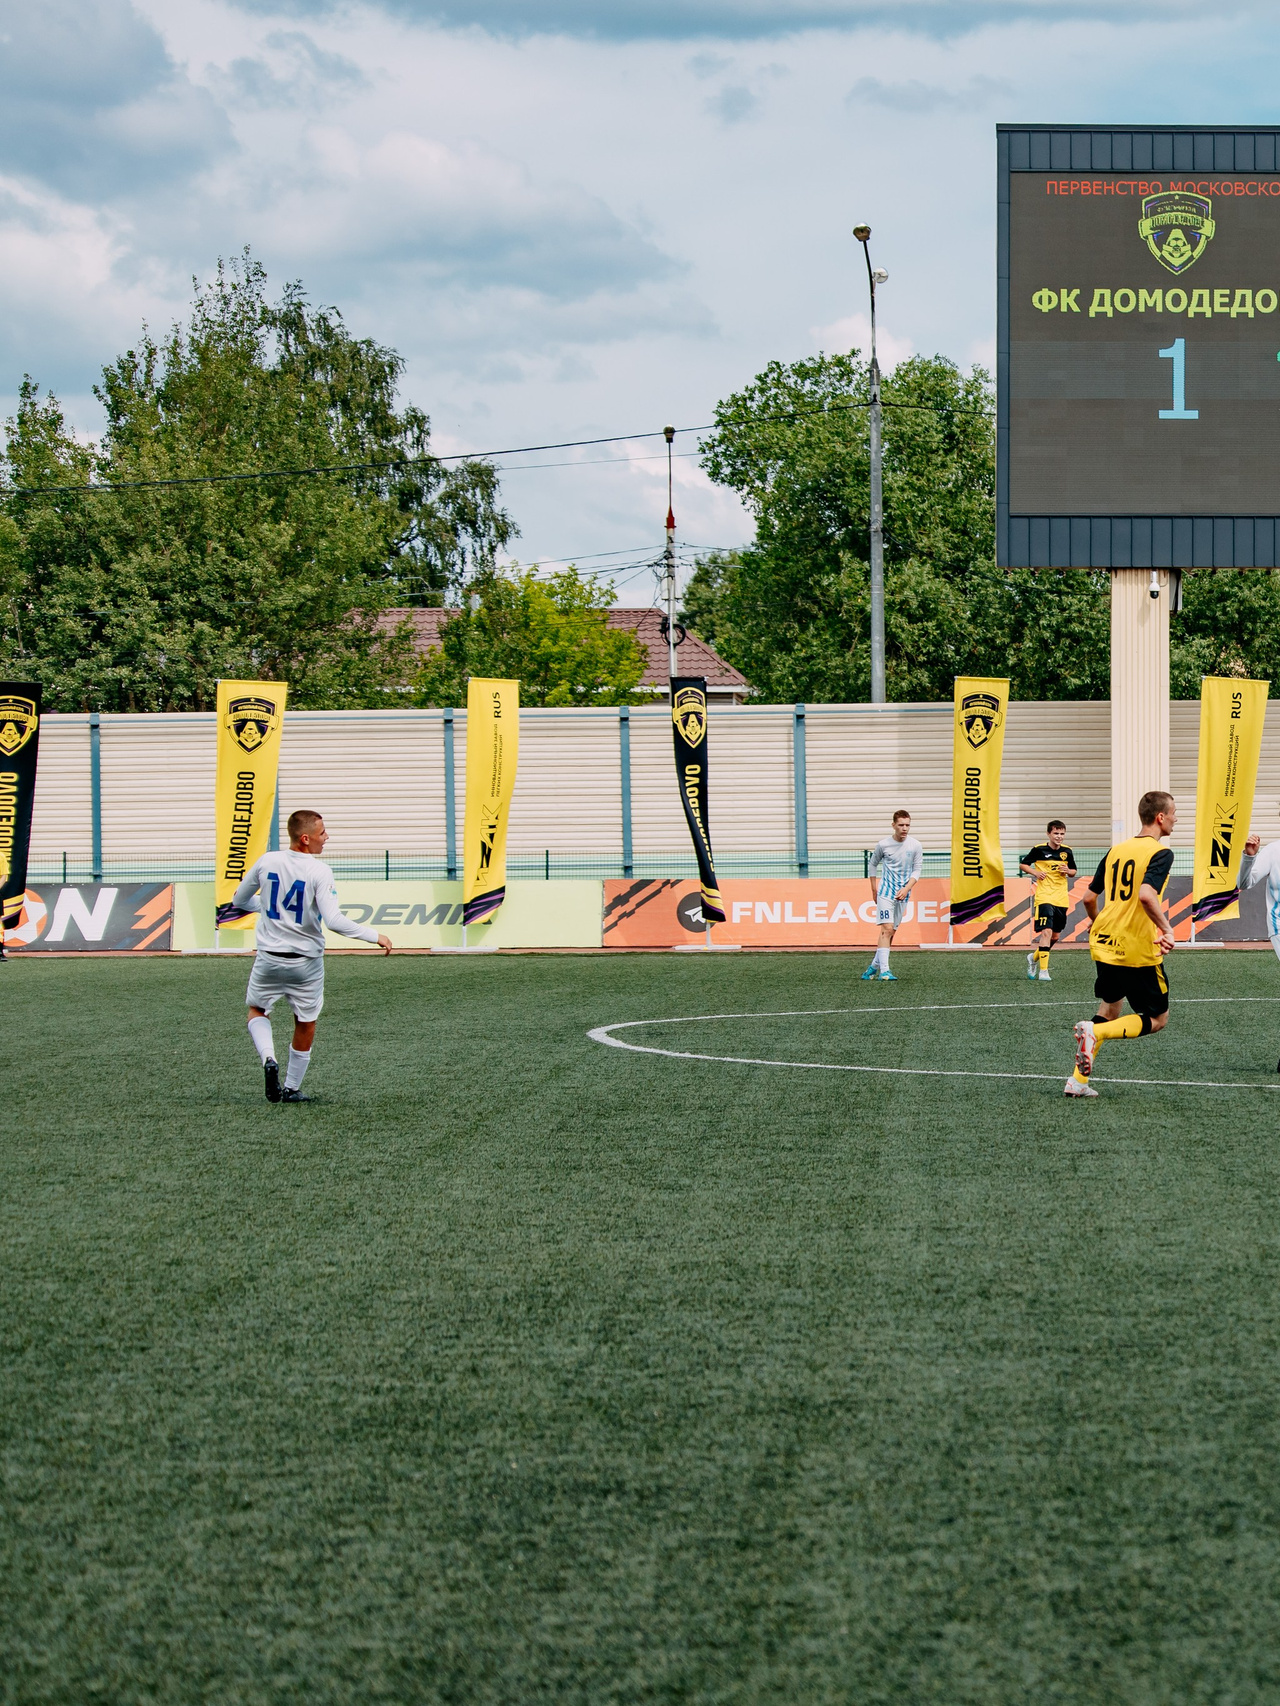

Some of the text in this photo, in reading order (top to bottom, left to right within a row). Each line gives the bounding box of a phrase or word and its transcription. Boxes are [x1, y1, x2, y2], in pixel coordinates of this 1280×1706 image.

[1046, 180, 1163, 196] ПЕРВЕНСТВО
[1031, 288, 1081, 313] ФК
[1158, 338, 1199, 420] 1
[491, 691, 502, 719] RUS
[1231, 692, 1243, 719] RUS
[1224, 743, 1233, 797] ИННОВАЦИОННЫЙ
[224, 771, 256, 881] ДОМОДЕДОВО
[963, 767, 982, 879] ДОМОДЕДОВО
[1110, 858, 1136, 902] 19
[266, 872, 307, 925] 14
[335, 903, 494, 926] DEMI
[880, 909, 890, 920] 88
[1039, 916, 1048, 926] 77
